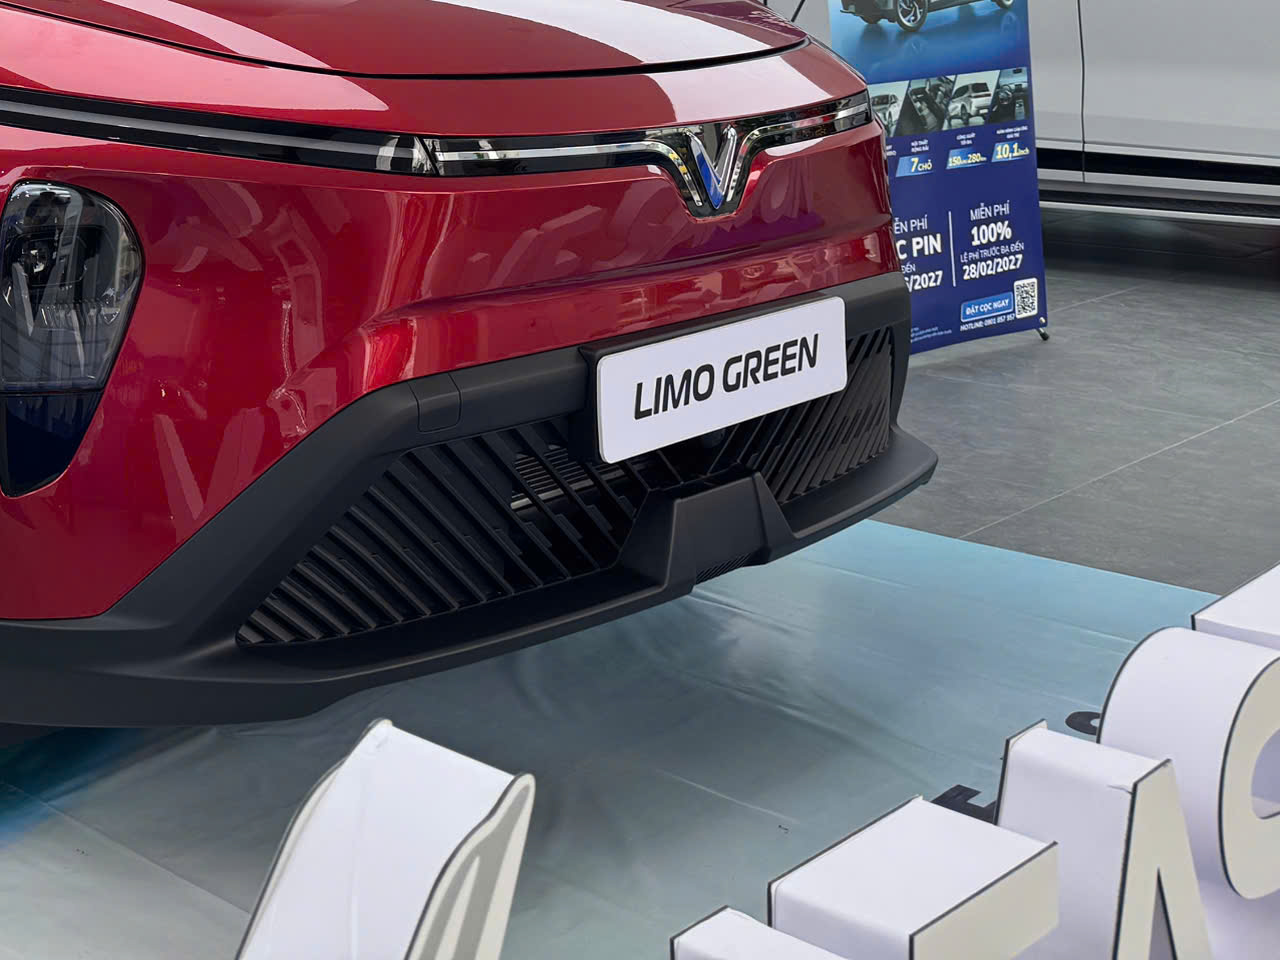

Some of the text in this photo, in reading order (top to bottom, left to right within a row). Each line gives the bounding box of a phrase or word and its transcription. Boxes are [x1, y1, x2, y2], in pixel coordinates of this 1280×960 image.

[970, 200, 1010, 221] MIỄN PHÍ
[894, 214, 928, 235] ỄN PHÍ
[970, 220, 1013, 246] 100%
[911, 233, 942, 258] PIN
[962, 254, 1023, 280] 28/02/2027
[634, 333, 819, 420] LIMO GREEN
